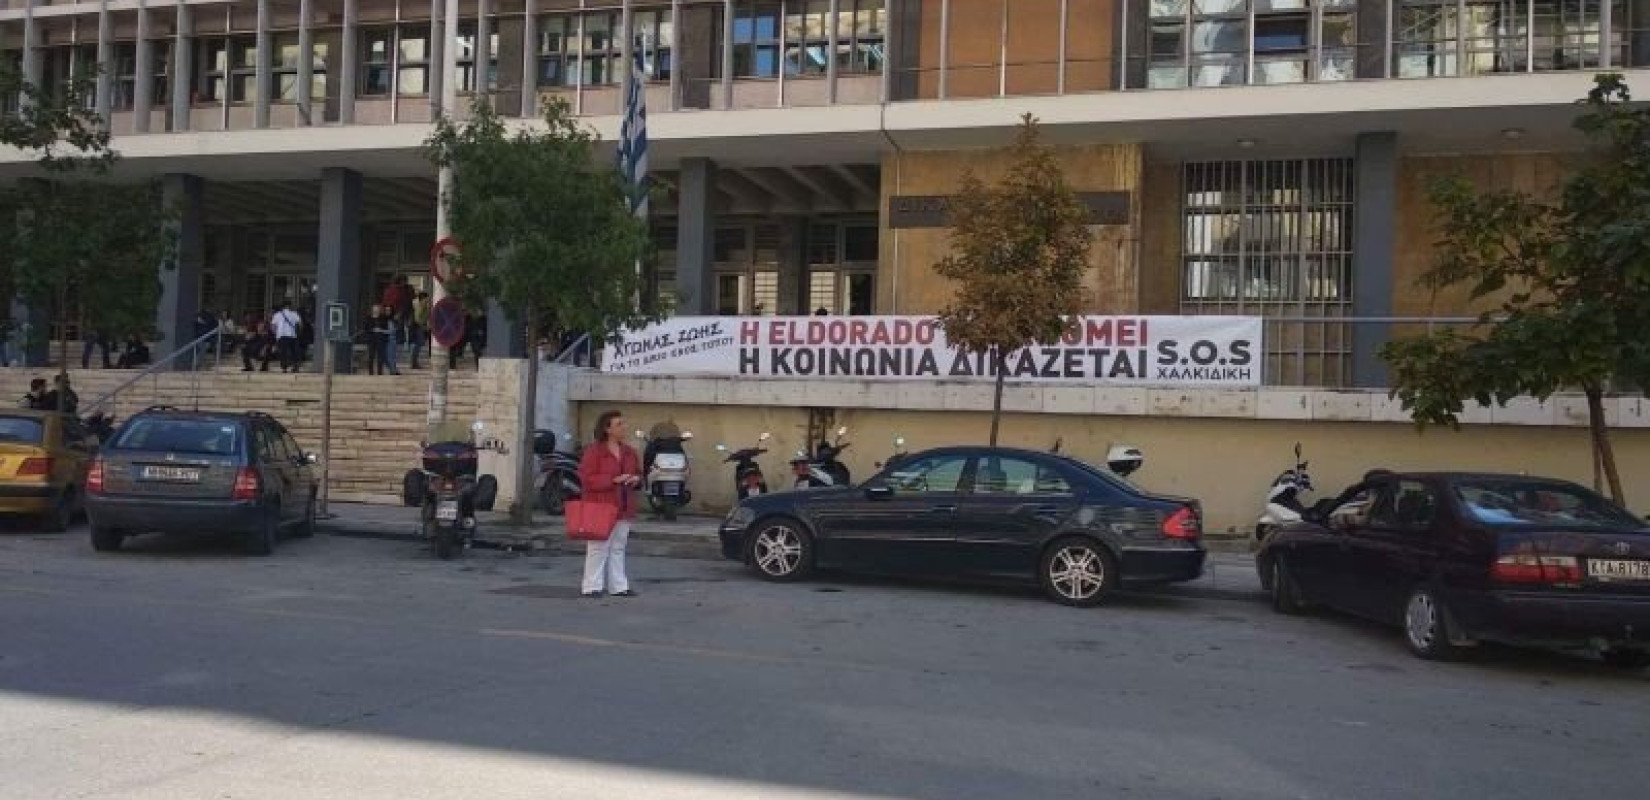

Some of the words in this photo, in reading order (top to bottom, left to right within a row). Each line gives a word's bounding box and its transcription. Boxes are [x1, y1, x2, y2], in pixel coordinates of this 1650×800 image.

[740, 321, 759, 345] Η
[768, 319, 935, 345] ELDORADO
[739, 348, 759, 375] Η
[770, 348, 939, 376] ΚΟΙΝΩΝΙΑ
[1156, 338, 1252, 366] S.O.S
[1156, 367, 1251, 380] ΧΑΛΚΙΔΙΚΗ
